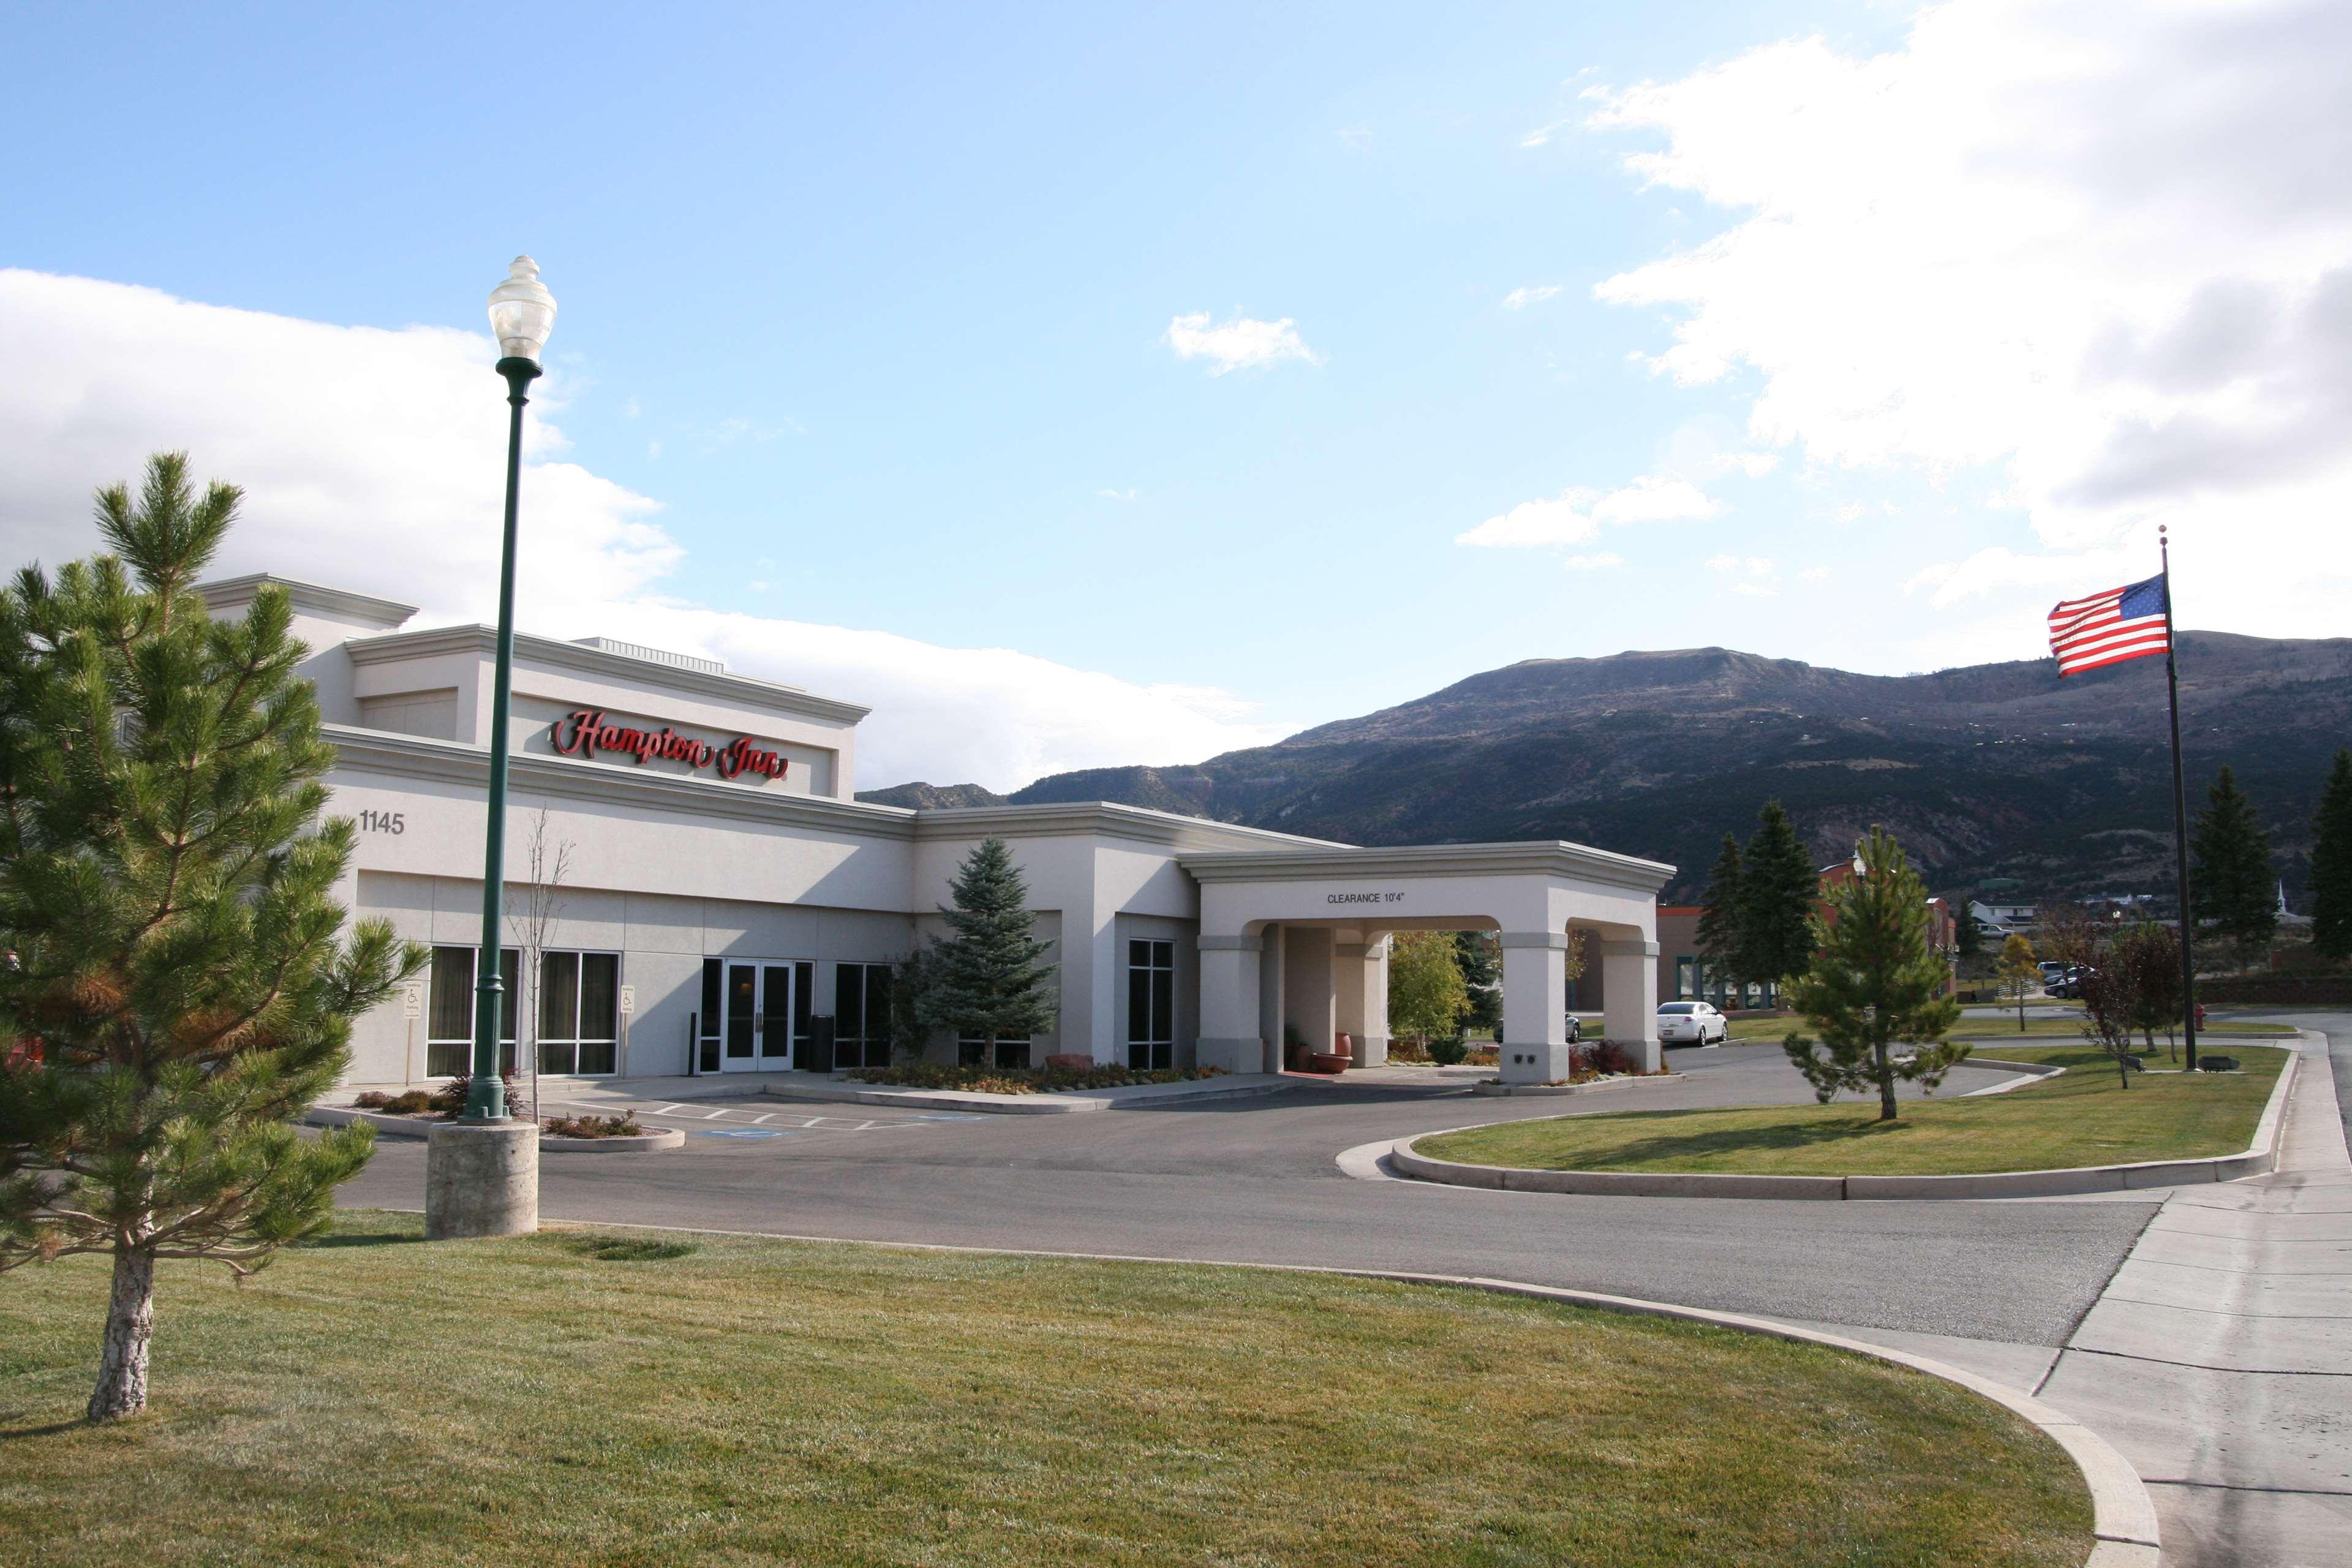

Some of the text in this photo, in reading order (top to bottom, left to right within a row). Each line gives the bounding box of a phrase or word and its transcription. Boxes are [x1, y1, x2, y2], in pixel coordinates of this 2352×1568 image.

[553, 710, 788, 779] Hampton Inn
[360, 810, 404, 835] 1145
[1327, 892, 1404, 903] CLEARANCE 10'4"
